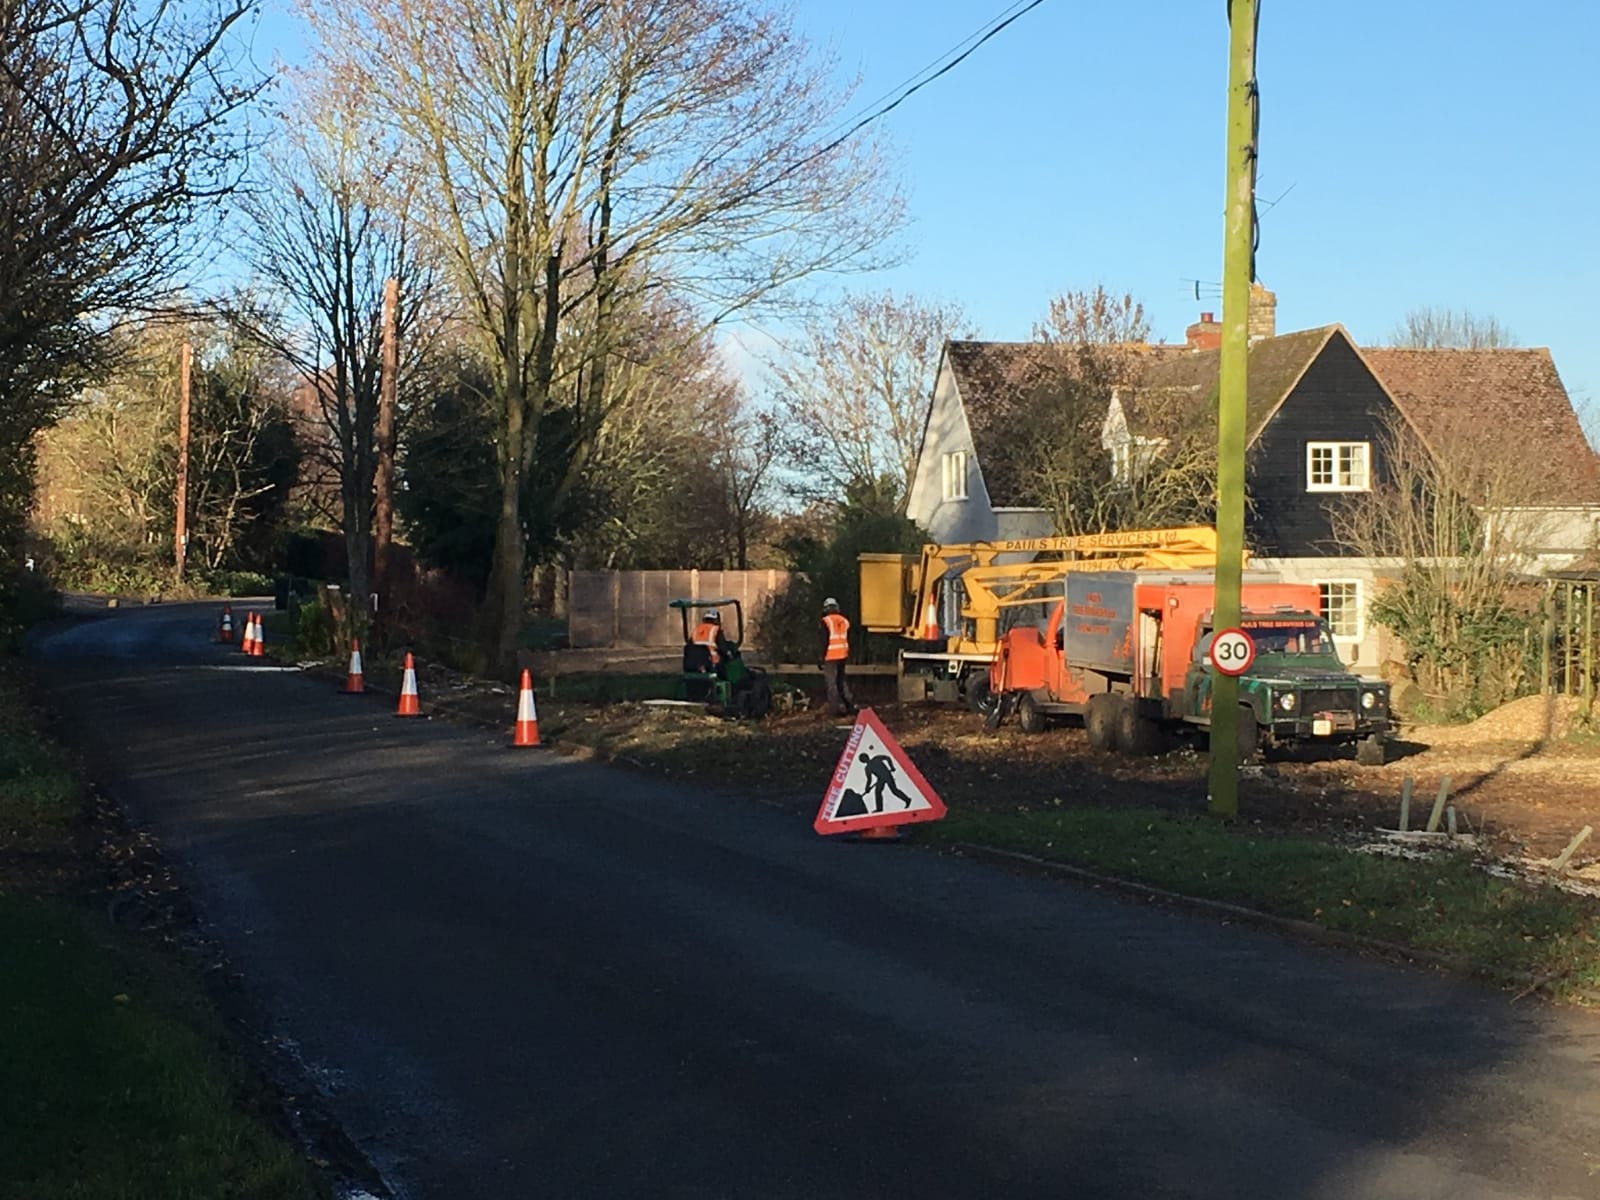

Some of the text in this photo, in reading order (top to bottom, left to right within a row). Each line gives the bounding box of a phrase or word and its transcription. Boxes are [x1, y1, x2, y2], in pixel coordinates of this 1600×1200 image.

[1089, 532, 1154, 546] SERVICES
[1241, 621, 1257, 629] AULS
[1218, 642, 1248, 661] 30
[820, 723, 864, 820] TREE CUTTING
